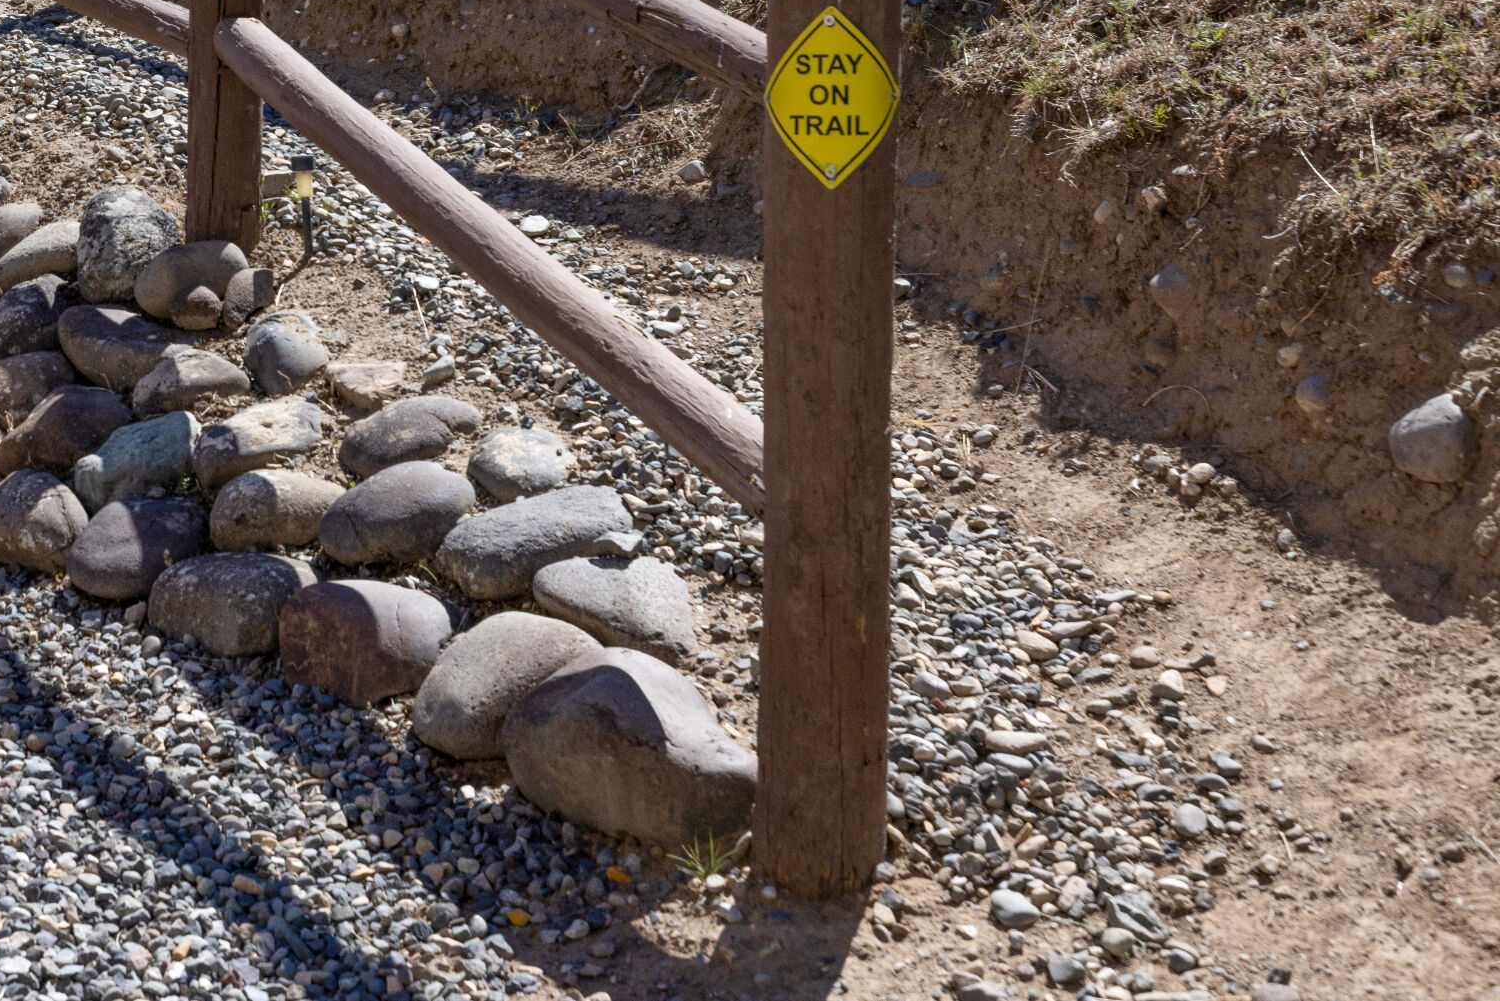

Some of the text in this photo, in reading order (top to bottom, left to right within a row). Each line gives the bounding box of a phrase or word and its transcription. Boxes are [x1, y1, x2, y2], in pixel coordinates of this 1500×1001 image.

[795, 53, 864, 75] STAY
[809, 84, 849, 105] ON
[789, 114, 870, 136] TRAIL
